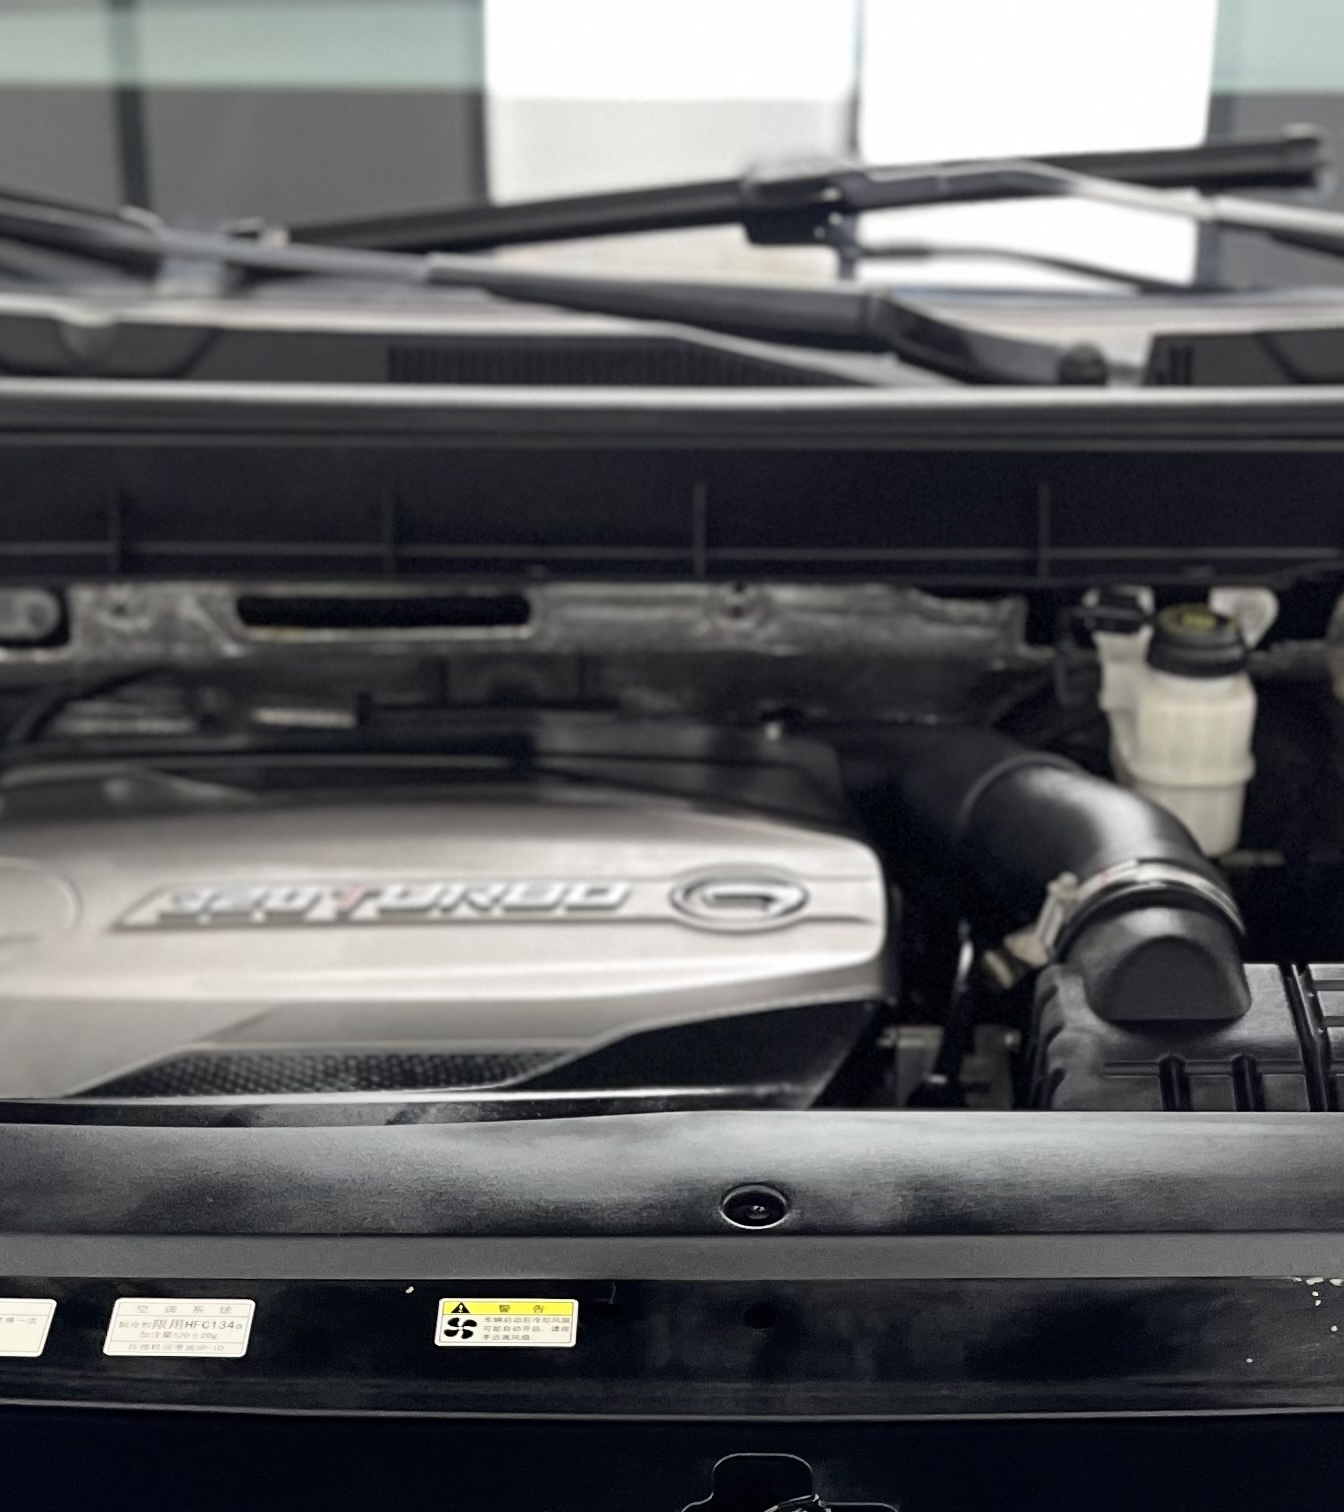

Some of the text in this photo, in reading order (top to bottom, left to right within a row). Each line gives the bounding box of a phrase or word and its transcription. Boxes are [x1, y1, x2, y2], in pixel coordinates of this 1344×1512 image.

[136, 1305, 233, 1315] 空调系统
[498, 1304, 545, 1314] 警告
